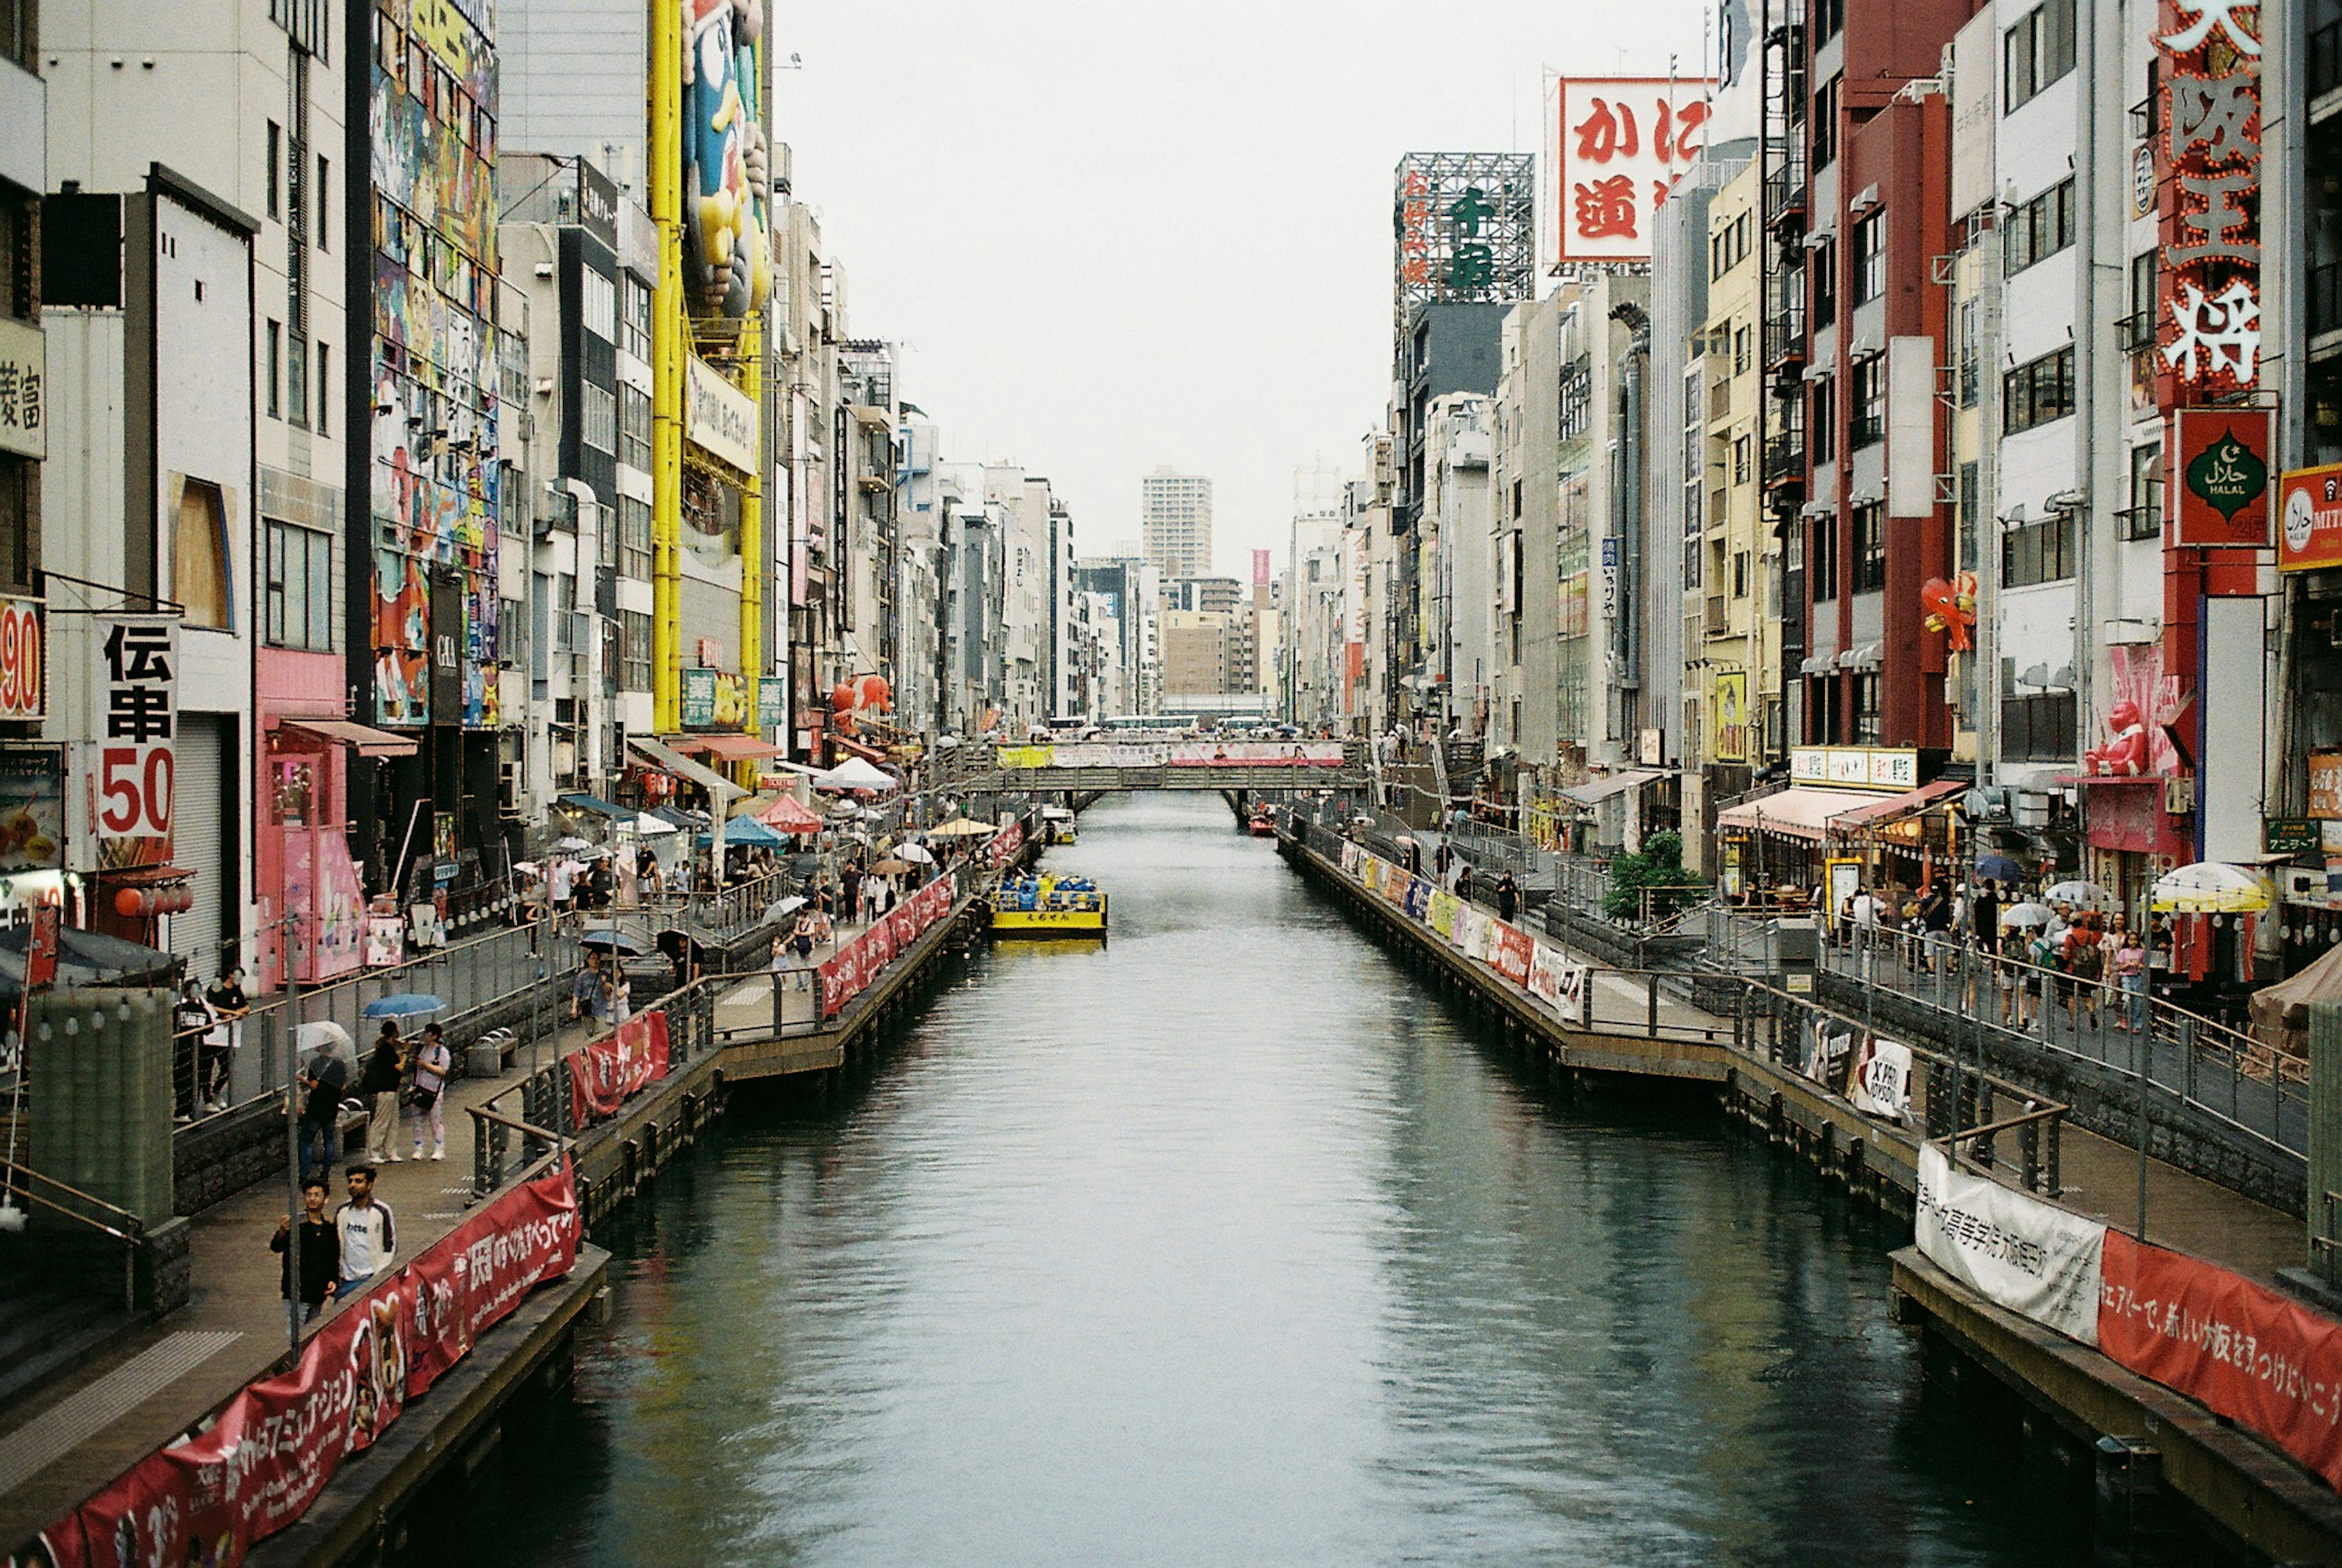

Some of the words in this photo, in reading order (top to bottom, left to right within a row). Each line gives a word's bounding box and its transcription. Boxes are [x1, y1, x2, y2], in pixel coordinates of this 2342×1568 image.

[1574, 98, 1712, 164] かに
[1450, 187, 1495, 289] 千房
[1574, 174, 1683, 239] 道
[2210, 485, 2245, 495] HALAL
[104, 624, 173, 743] 伝串
[101, 747, 174, 832] 50
